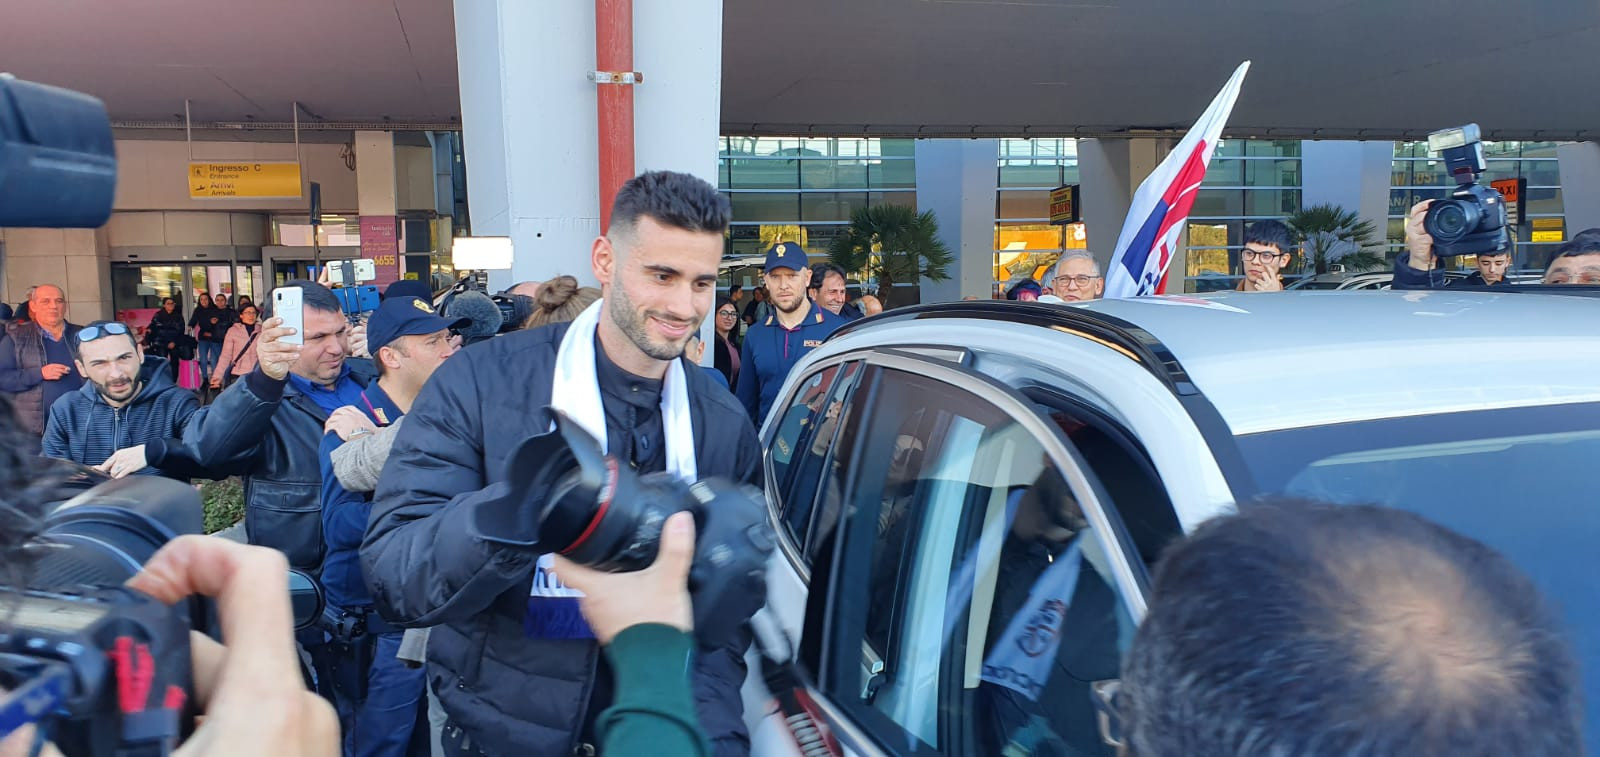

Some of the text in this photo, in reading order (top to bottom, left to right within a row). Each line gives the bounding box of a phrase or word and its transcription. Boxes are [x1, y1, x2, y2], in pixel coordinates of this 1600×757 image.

[209, 164, 261, 173] Ingresso C
[374, 254, 395, 266] 6655
